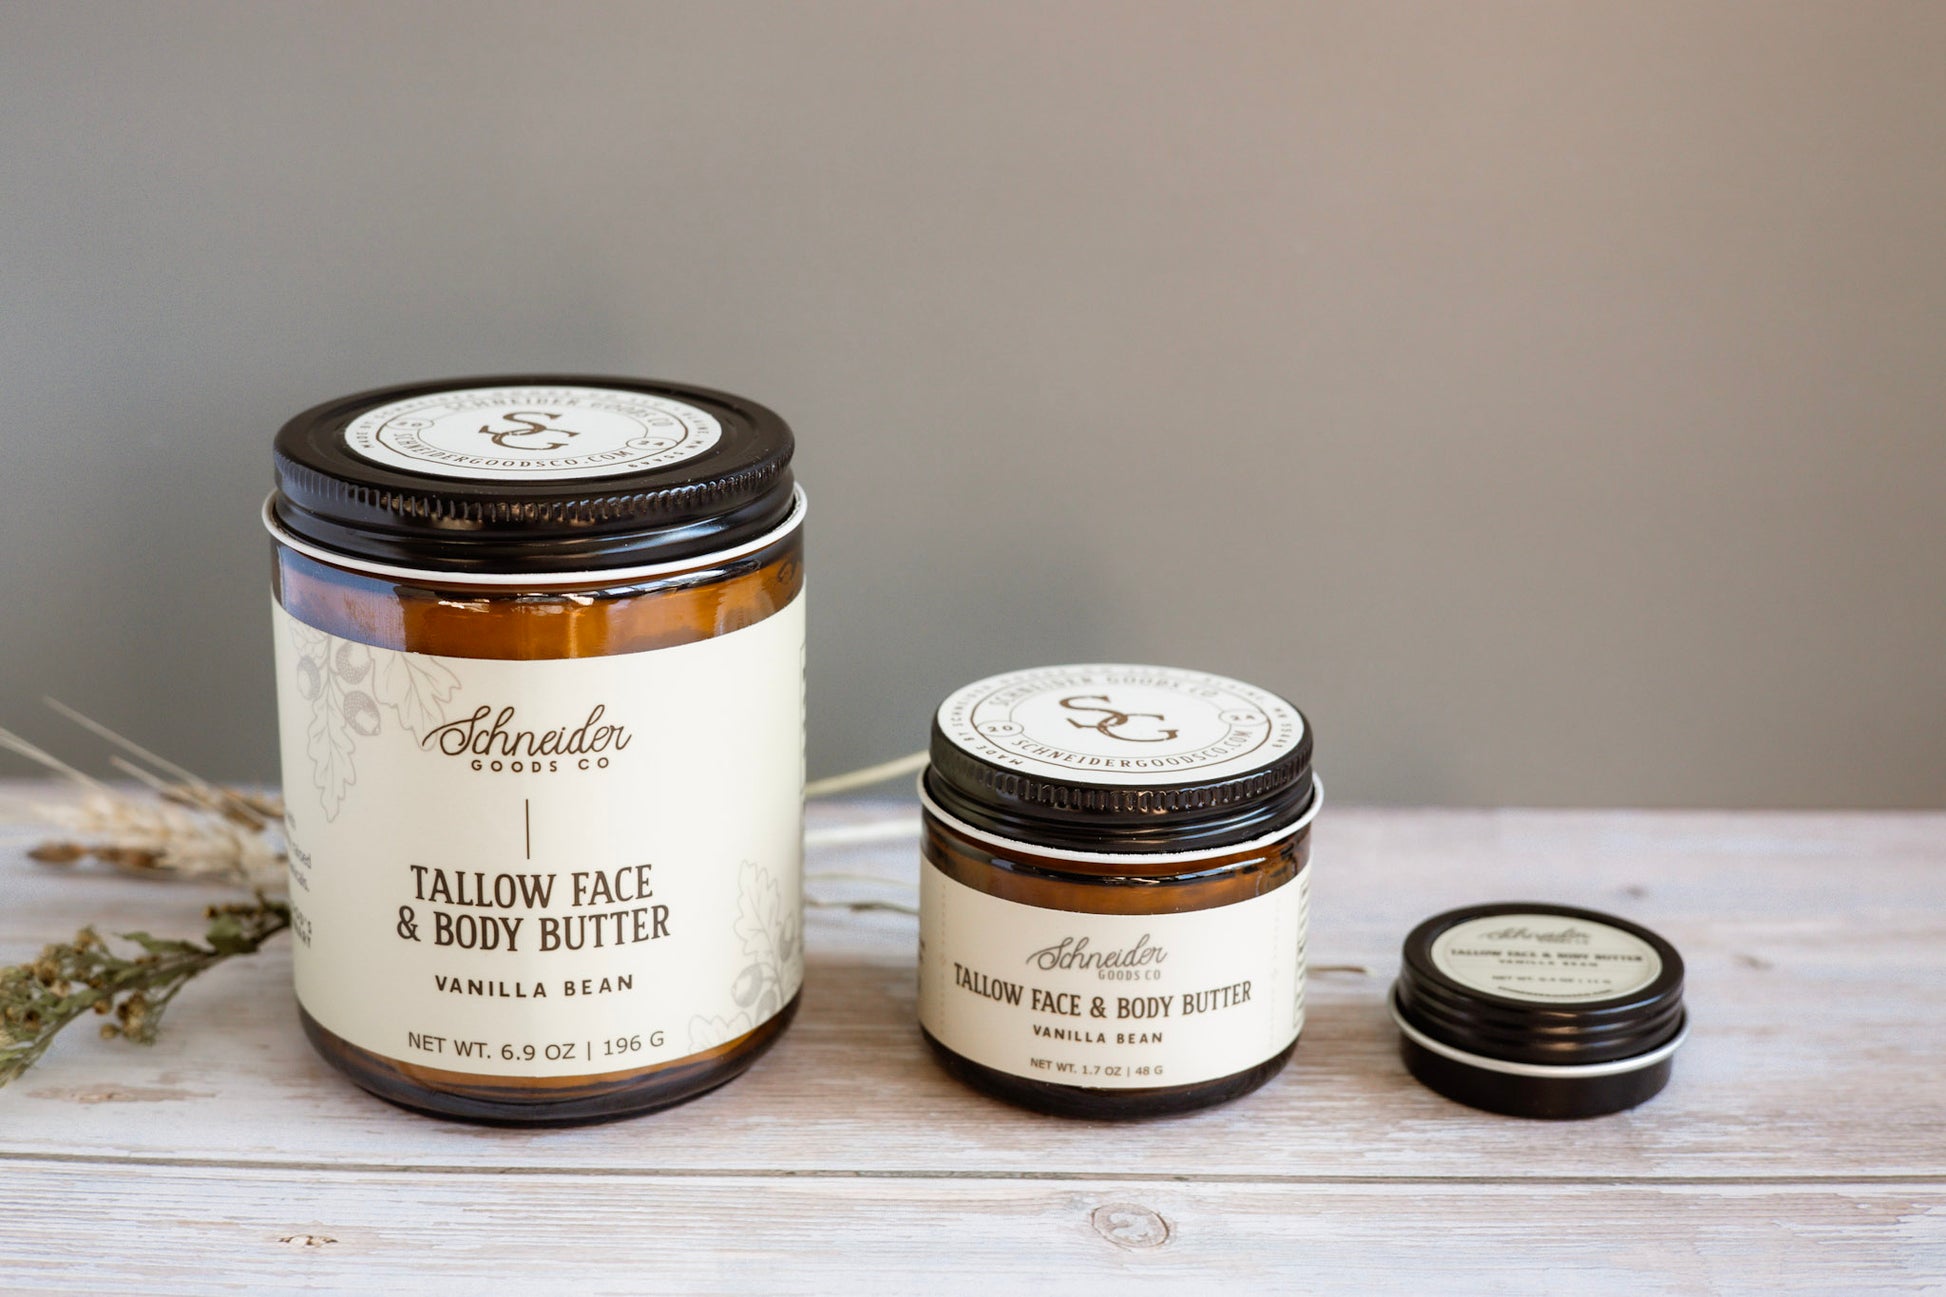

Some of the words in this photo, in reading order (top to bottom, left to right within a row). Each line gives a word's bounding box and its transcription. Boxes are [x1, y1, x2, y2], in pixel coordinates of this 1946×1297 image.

[422, 704, 632, 756] Schneider
[471, 759, 557, 773] GOODS
[578, 757, 609, 770] CO
[410, 864, 557, 909] TALLOW
[571, 863, 654, 907] FACE
[396, 905, 421, 942] &
[434, 910, 524, 952] BODY
[539, 904, 671, 952] BUTTER
[1026, 934, 1168, 970] Schneider
[435, 974, 547, 998] VANILLA
[564, 974, 633, 997] BEAN
[1098, 969, 1140, 981] GOODS
[1145, 968, 1161, 980] CO
[954, 962, 1024, 1006] TALLOW
[1031, 988, 1081, 1017] FACE
[1090, 996, 1107, 1019] &
[1117, 996, 1174, 1019] BODY
[1182, 980, 1252, 1016] BUTTER
[408, 1031, 446, 1053] NET
[454, 1039, 491, 1059] WT.
[501, 1043, 536, 1061] 6.9
[545, 1043, 576, 1060] OZ
[603, 1035, 642, 1056] 196
[650, 1031, 665, 1047] G
[1033, 1023, 1106, 1044] VANILLA
[1116, 1032, 1163, 1044] BEAN
[1030, 1057, 1052, 1070] NET
[1056, 1062, 1077, 1074] WT.
[1082, 1064, 1100, 1075] 1.7
[1104, 1065, 1122, 1077] OZ
[1135, 1065, 1150, 1076] 48
[1154, 1065, 1164, 1075] G
